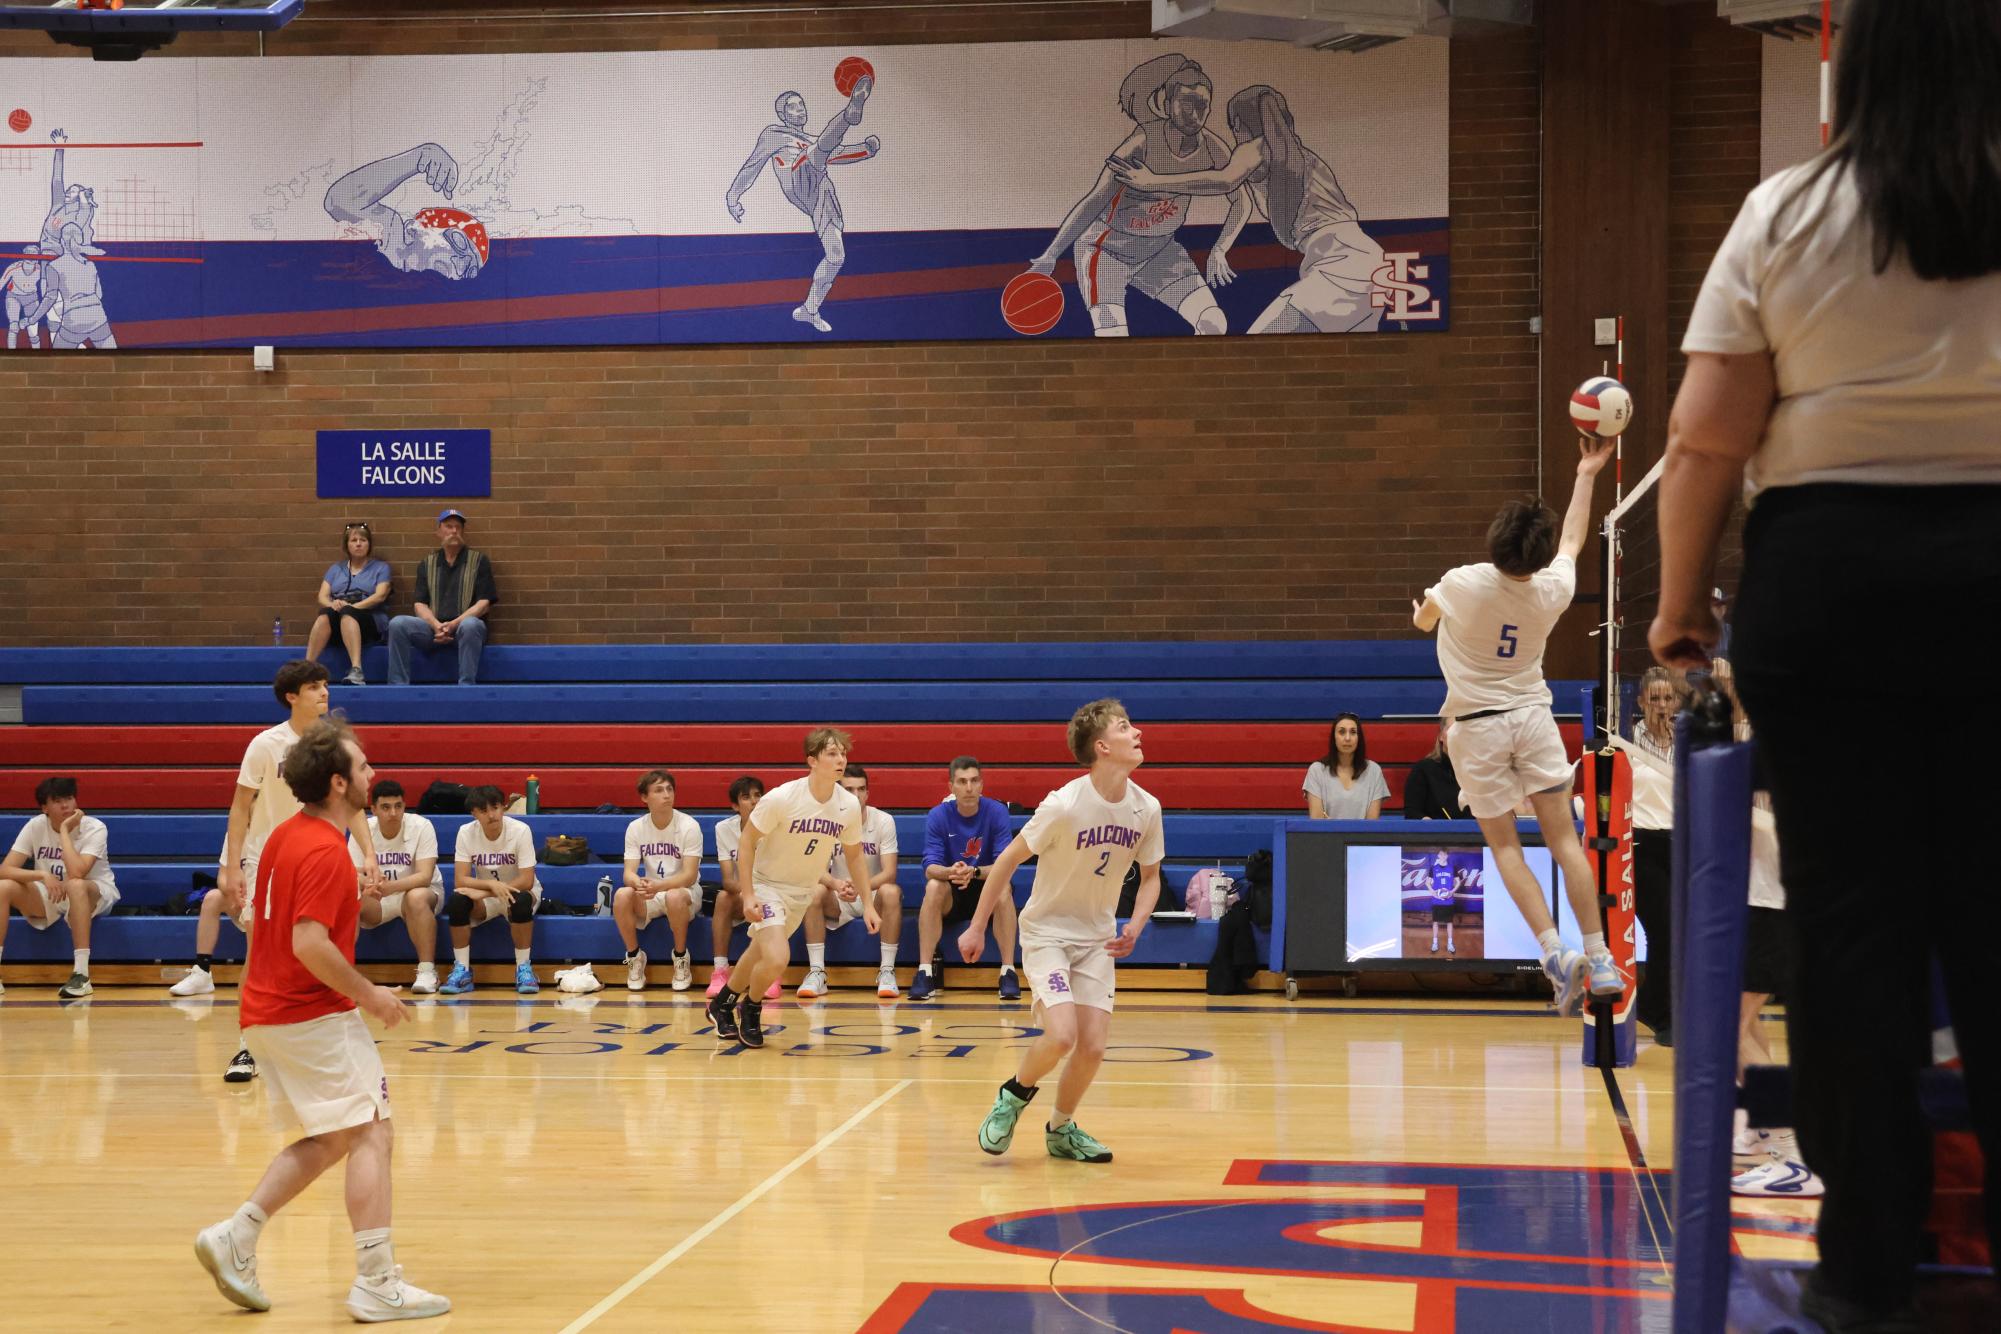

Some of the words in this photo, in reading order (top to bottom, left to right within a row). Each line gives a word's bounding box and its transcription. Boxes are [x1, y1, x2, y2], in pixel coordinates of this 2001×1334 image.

[361, 442, 386, 461] LA
[390, 442, 446, 461] SALLE
[361, 465, 446, 485] FALCONS
[1496, 623, 1519, 659] 5
[788, 818, 844, 839] FALCONS
[1075, 824, 1142, 850] FALCONS
[37, 846, 64, 860] FALC
[640, 842, 681, 860] FALCONS
[804, 838, 819, 856] 6
[376, 852, 412, 866] ALCONS
[471, 853, 517, 867] FALCONS
[1093, 851, 1111, 877] 2
[1621, 801, 1634, 913] SALLE
[656, 861, 665, 878] 4
[1624, 921, 1636, 968] LA
